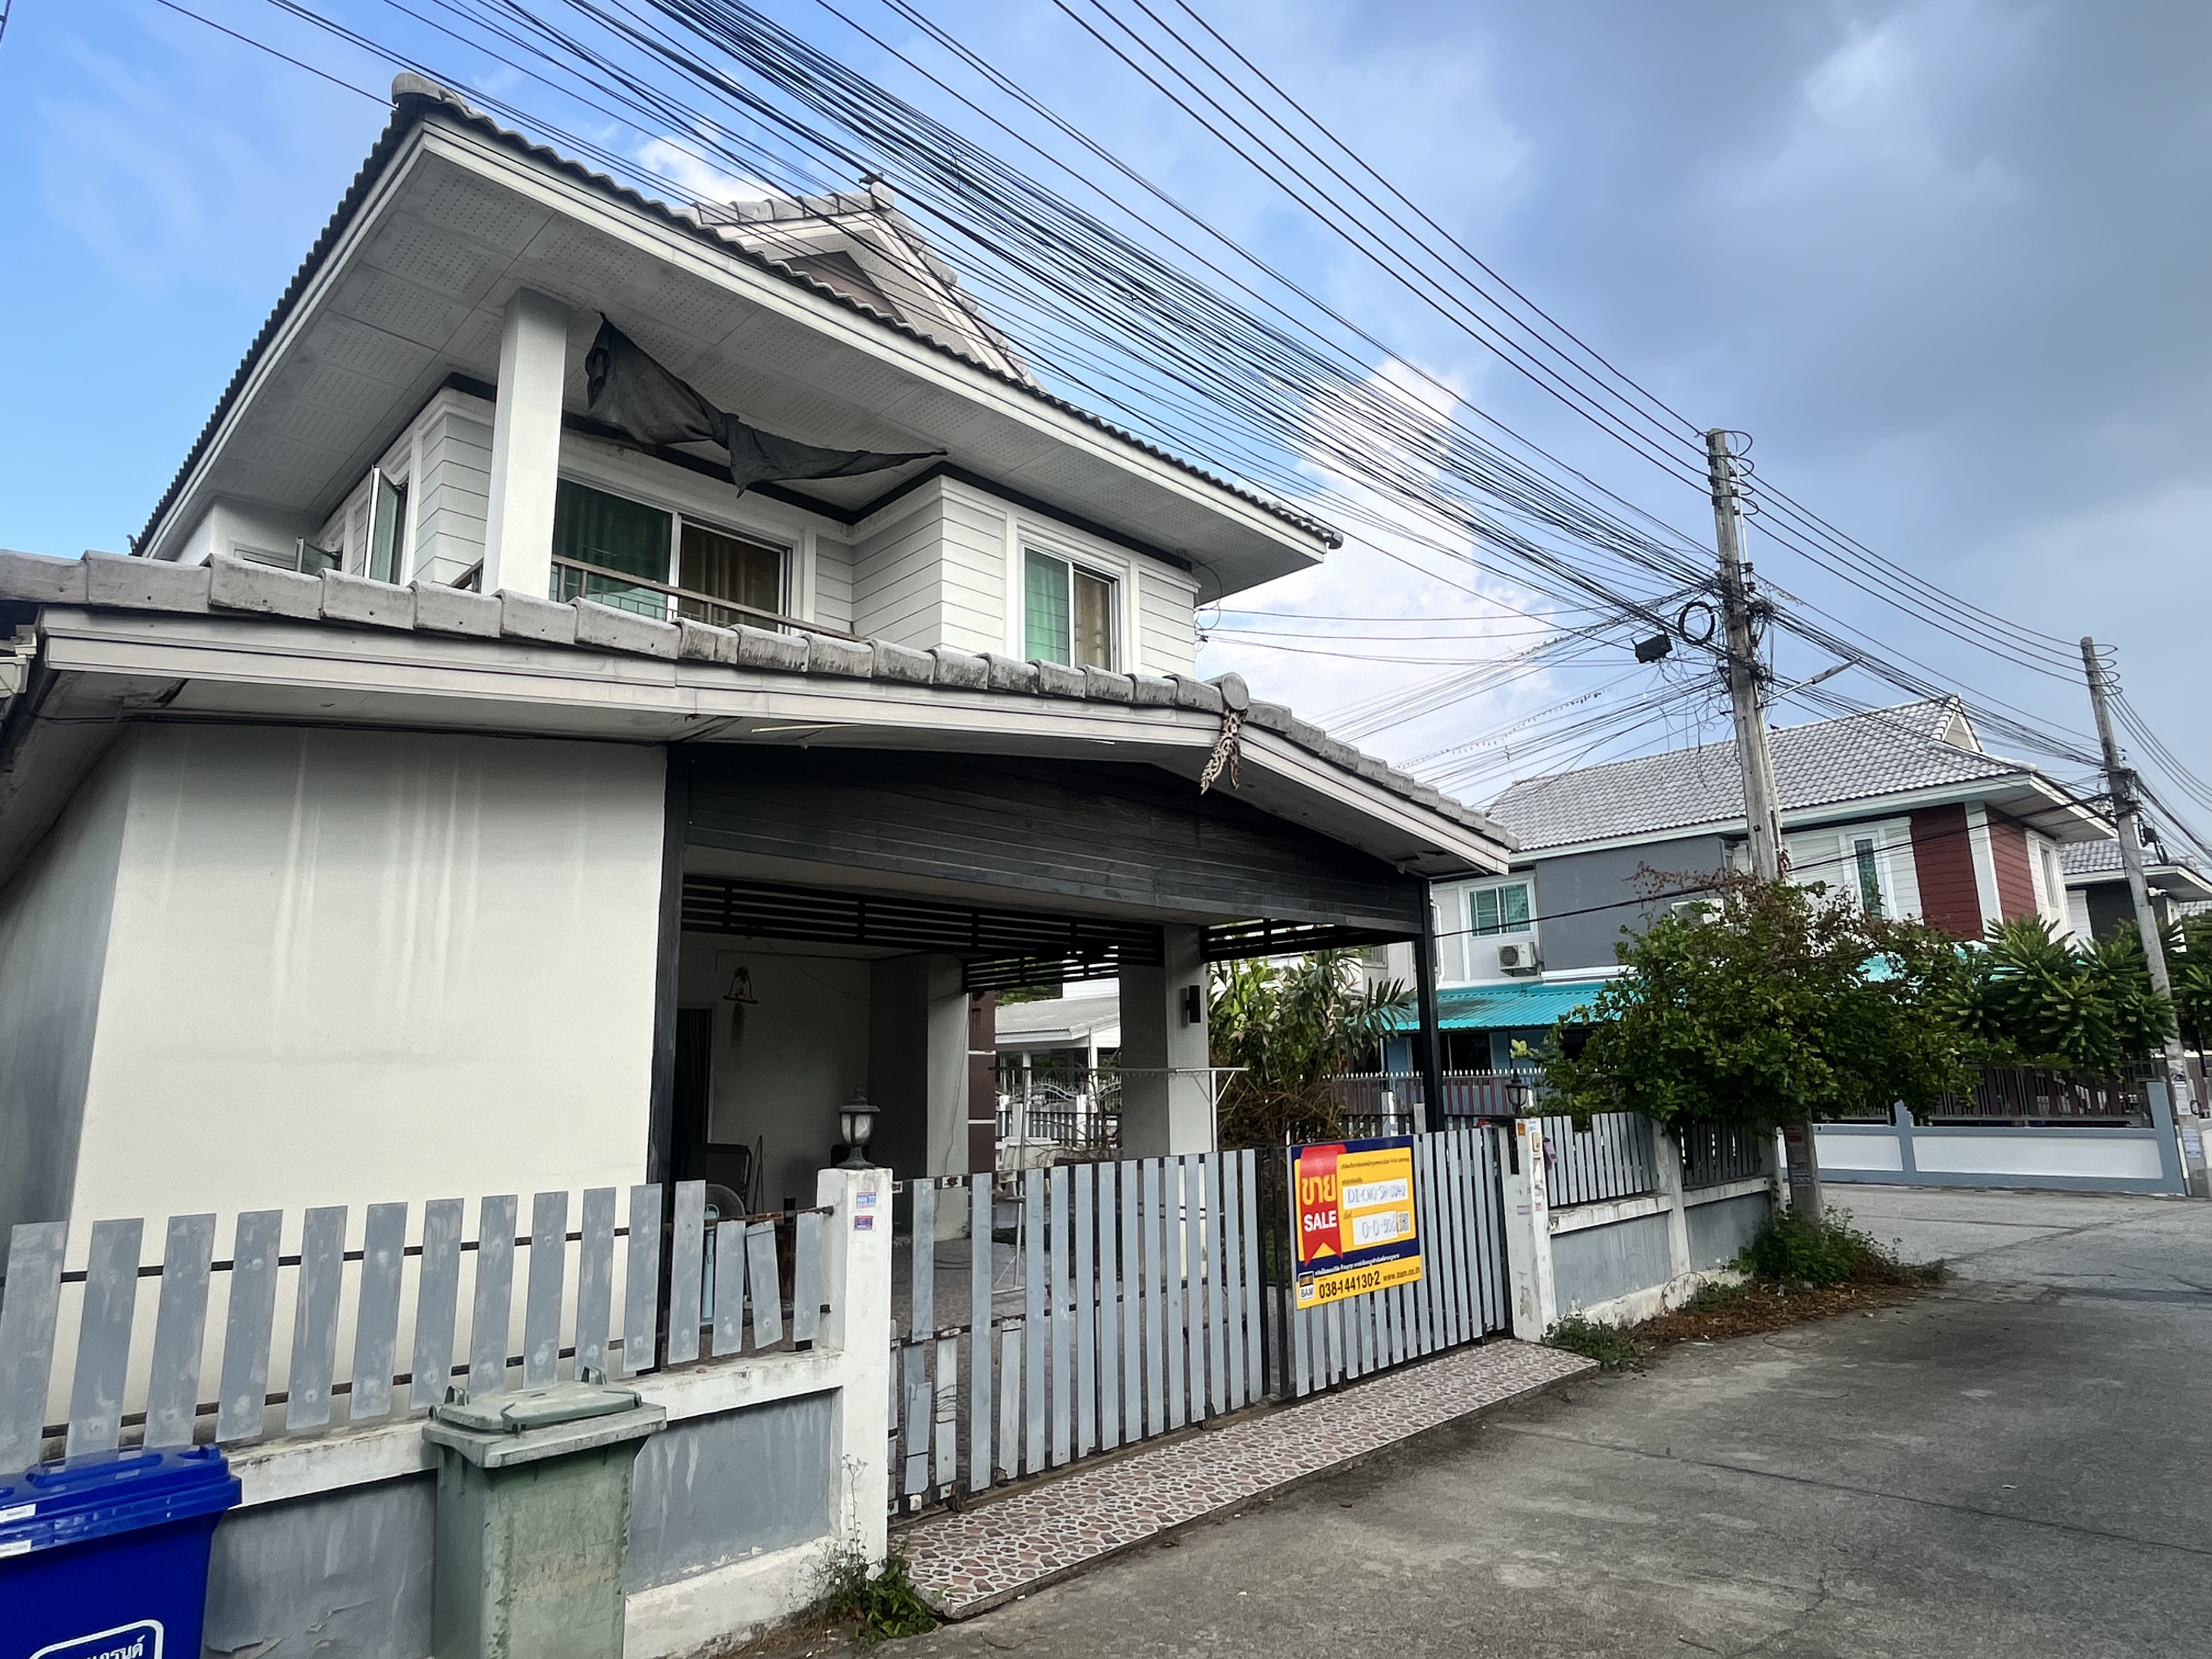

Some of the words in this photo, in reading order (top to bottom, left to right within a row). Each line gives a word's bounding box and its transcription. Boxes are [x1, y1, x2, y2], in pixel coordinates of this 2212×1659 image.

[1301, 1174, 1336, 1206] ขาย
[1304, 1209, 1338, 1232] SALE
[1300, 1286, 1313, 1299] BAM
[1319, 1271, 1380, 1299] 038-144130-2
